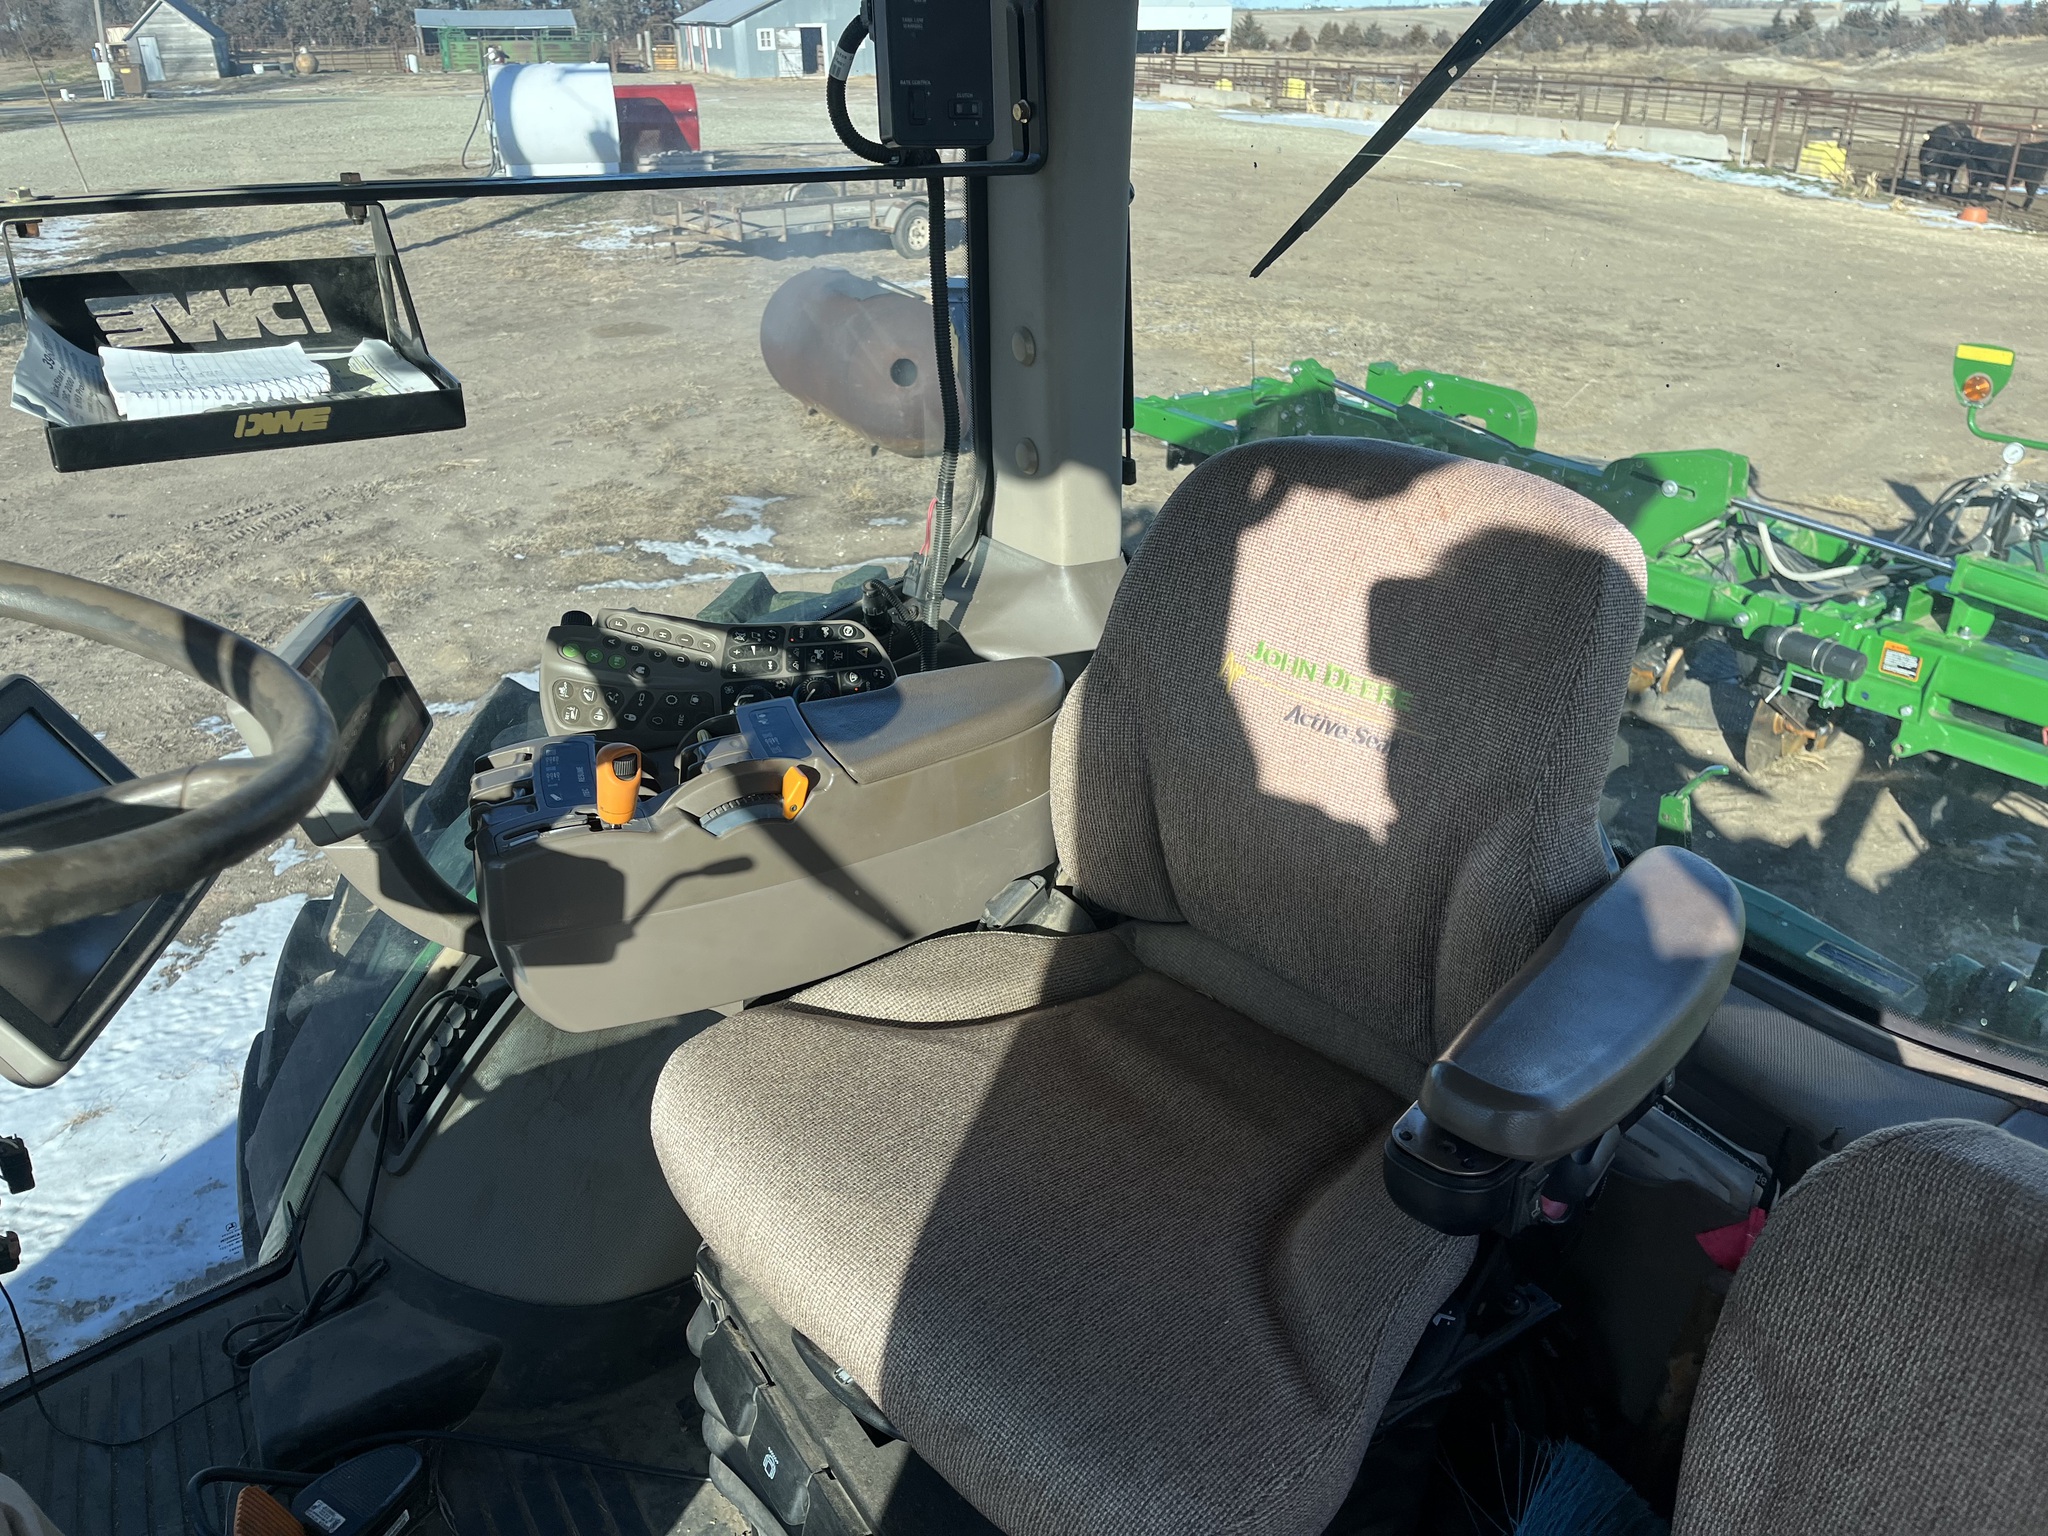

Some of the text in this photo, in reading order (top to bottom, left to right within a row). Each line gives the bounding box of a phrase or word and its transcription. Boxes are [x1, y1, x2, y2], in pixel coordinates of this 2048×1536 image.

[1249, 640, 1415, 712] JOHN DEERE
[1283, 704, 1399, 755] Active Sea
